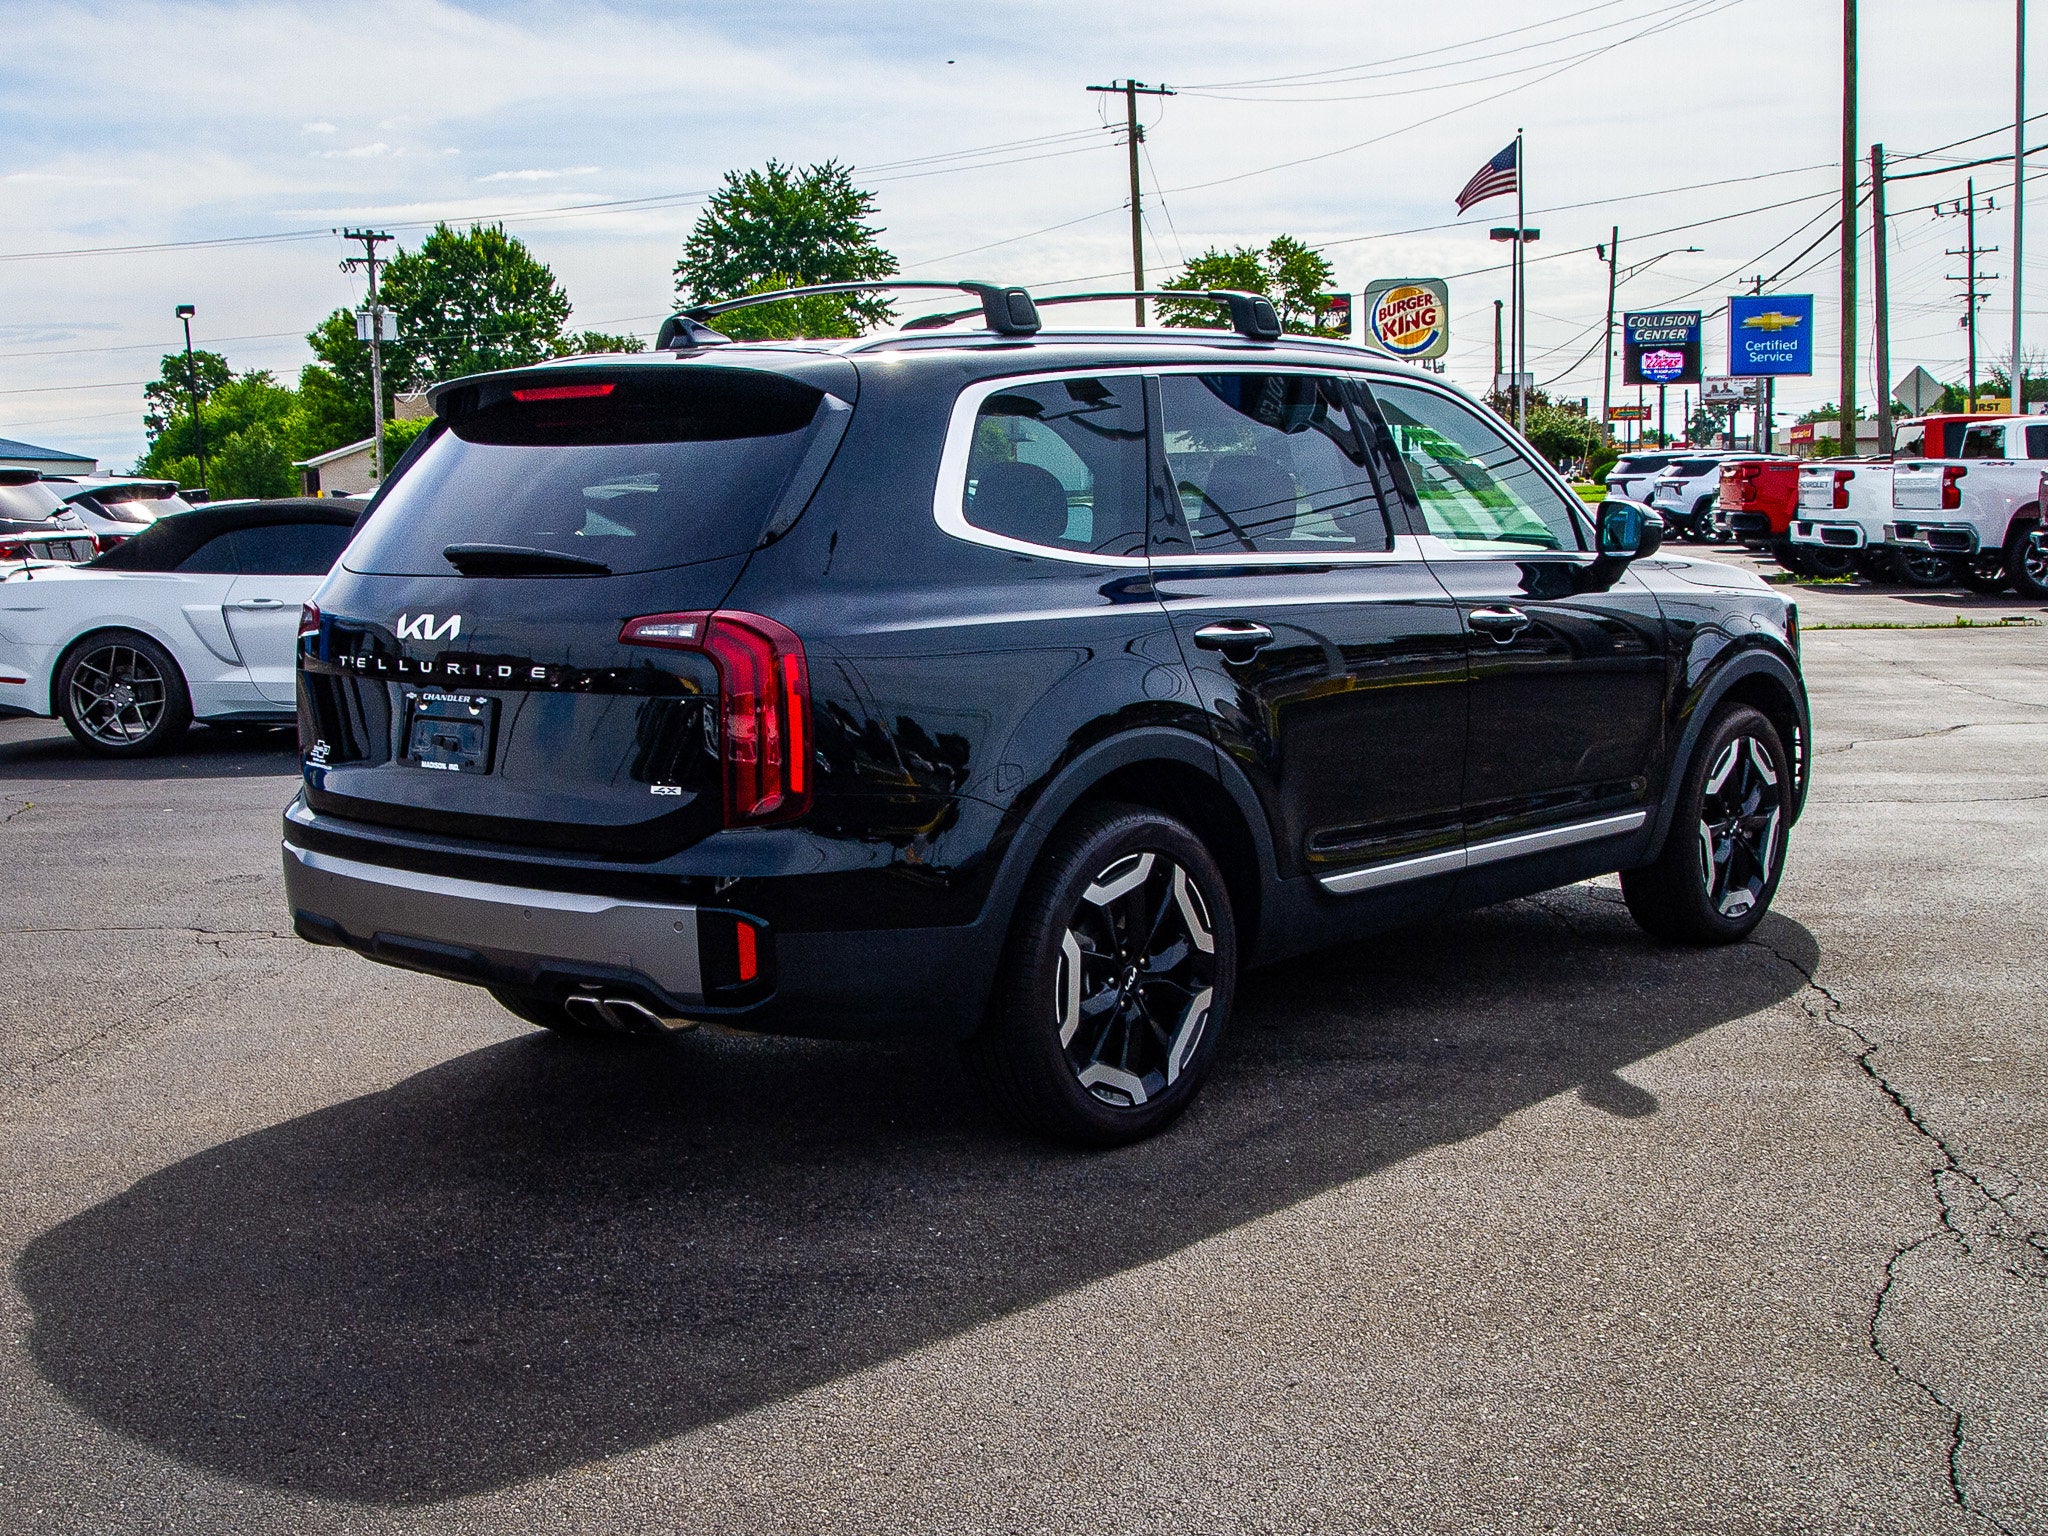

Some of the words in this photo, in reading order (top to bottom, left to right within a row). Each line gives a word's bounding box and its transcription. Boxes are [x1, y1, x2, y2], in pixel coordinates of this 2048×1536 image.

[1378, 293, 1433, 323] BURGER
[1382, 308, 1436, 342] KING
[1628, 315, 1696, 328] COLLISION
[1634, 328, 1687, 341] CENTER
[1745, 339, 1798, 351] Certified
[1749, 351, 1793, 362] Service
[396, 613, 461, 641] KIA
[339, 655, 546, 679] TELLURIDE
[422, 693, 471, 703] CHANDLER
